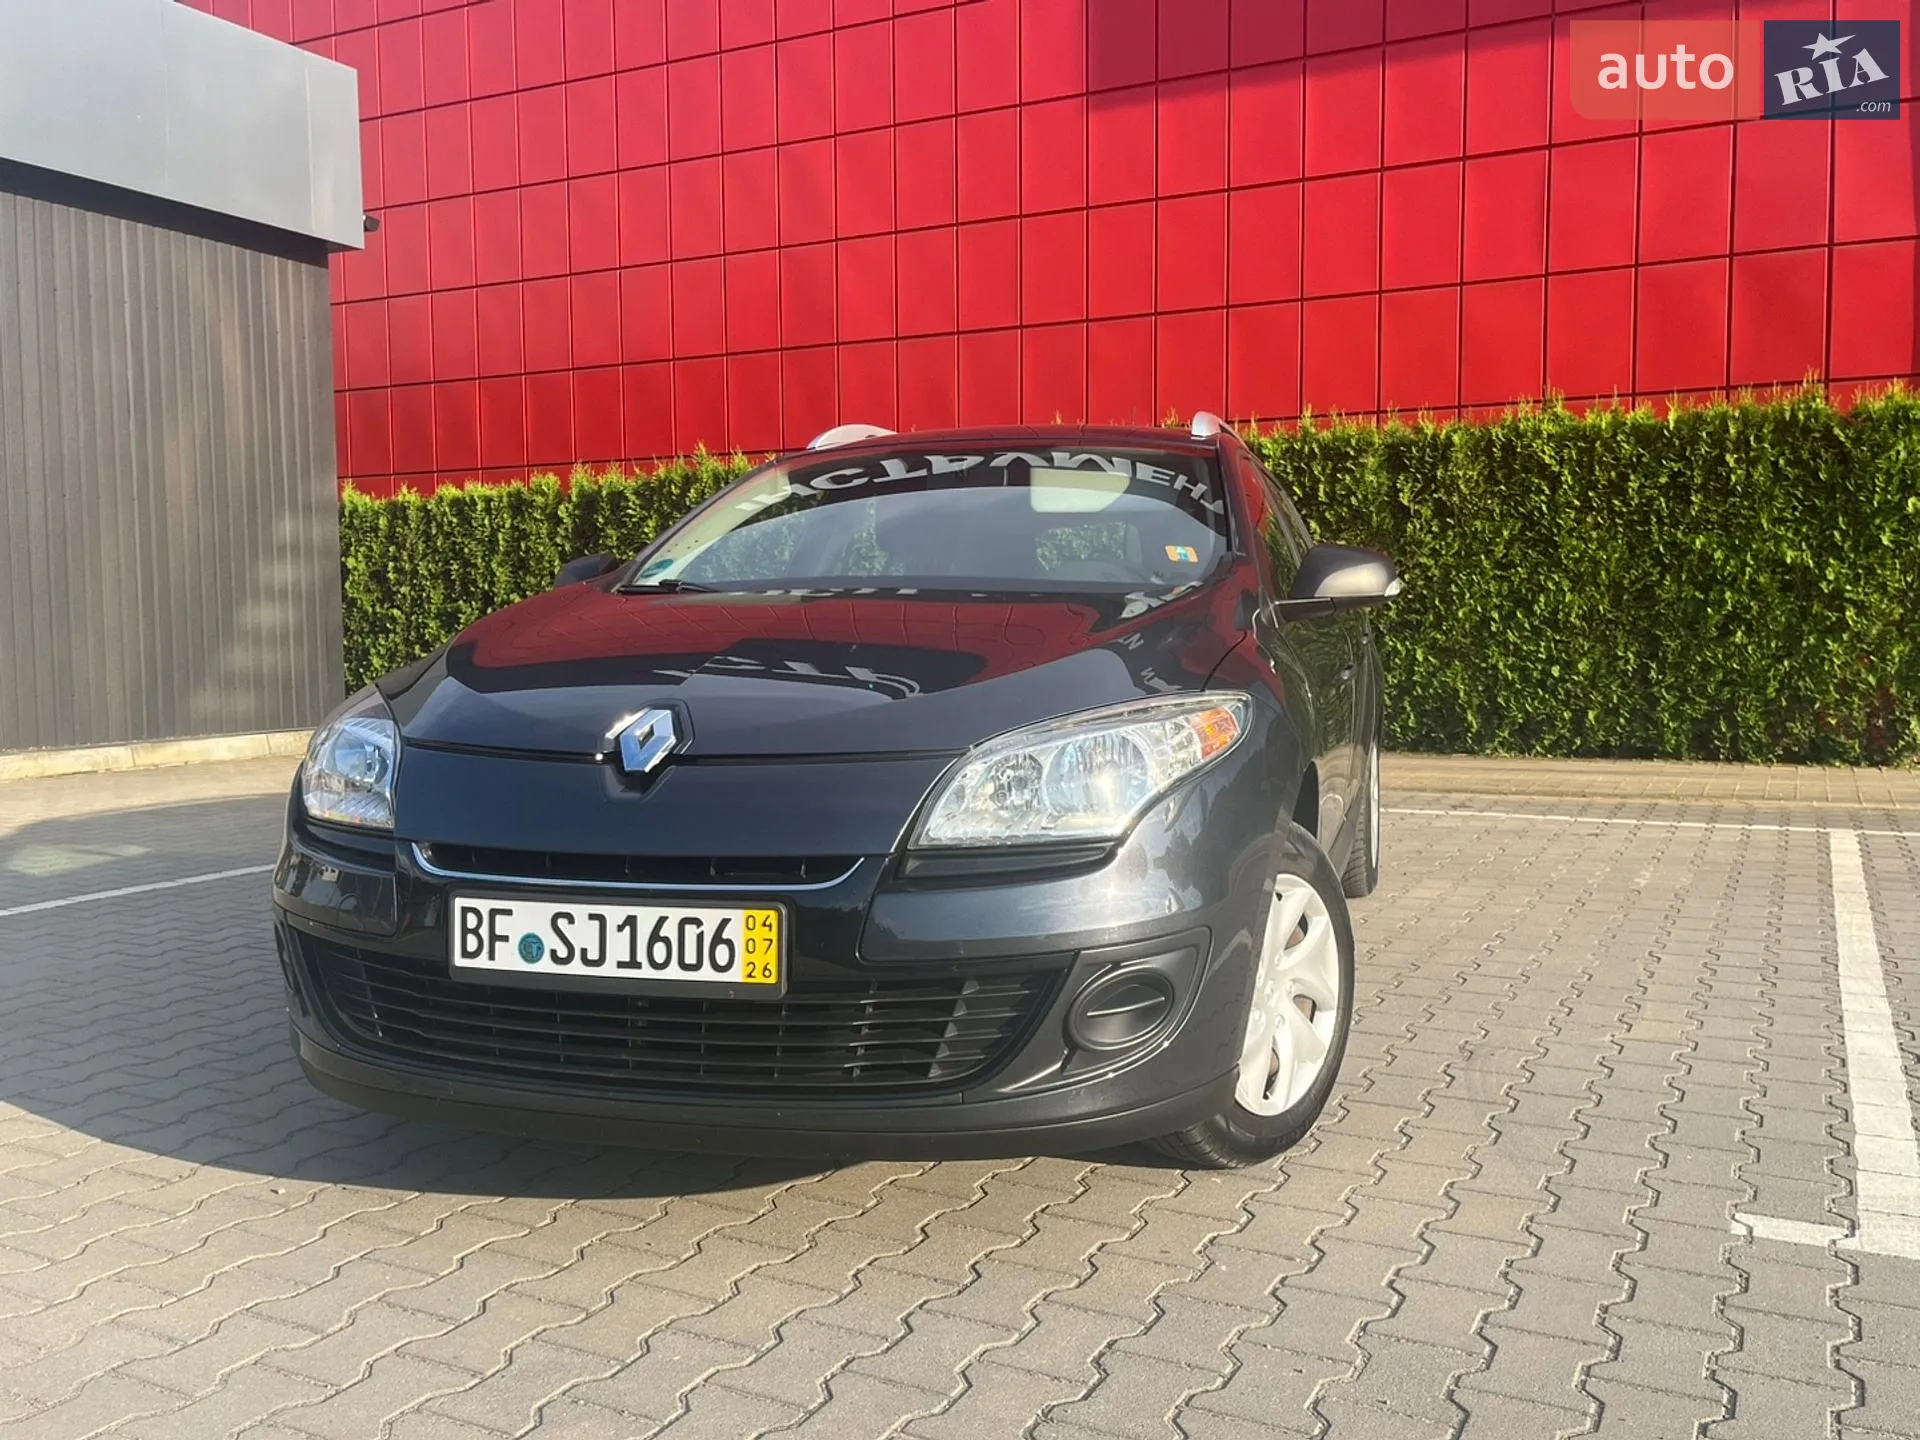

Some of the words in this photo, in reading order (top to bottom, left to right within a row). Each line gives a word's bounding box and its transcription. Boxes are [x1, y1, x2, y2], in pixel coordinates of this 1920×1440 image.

[745, 914, 773, 933] 04
[460, 905, 514, 962] BF
[745, 937, 774, 955] 07
[746, 961, 773, 979] 26
